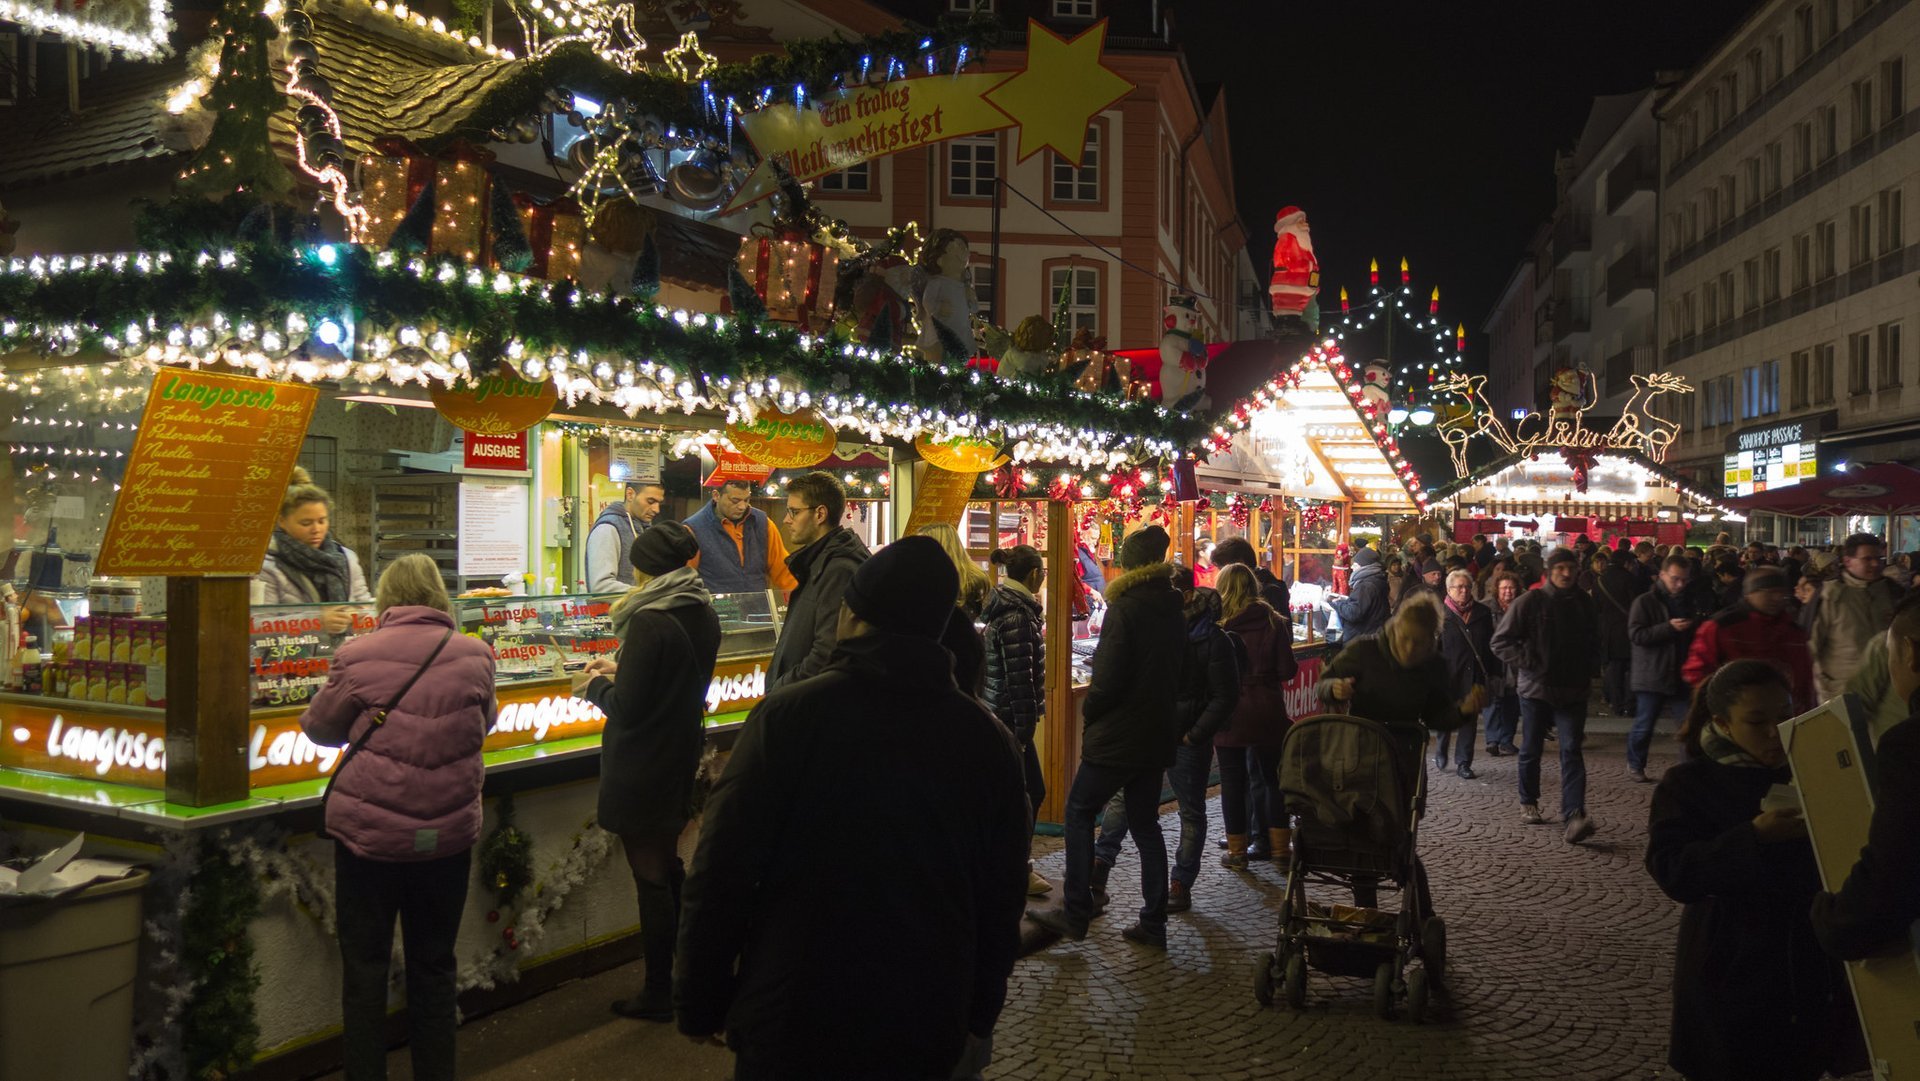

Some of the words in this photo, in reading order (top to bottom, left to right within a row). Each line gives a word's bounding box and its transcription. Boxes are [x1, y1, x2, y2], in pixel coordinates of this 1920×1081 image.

[819, 101, 851, 127] Ein
[856, 85, 910, 119] frohes
[162, 376, 276, 410] Langosch
[456, 416, 476, 428] mit
[481, 411, 512, 433] Käse
[1739, 430, 1770, 450] SANDHOF
[1772, 424, 1802, 444] PASSAGE
[142, 441, 193, 459] Nutella
[472, 443, 520, 458] AUSGABE
[482, 606, 537, 622] Langos
[249, 616, 322, 636] Langos
[256, 637, 276, 648] mit
[278, 635, 319, 645] Nutella
[570, 637, 620, 654] Langos
[491, 643, 547, 661] Langos
[254, 656, 330, 677] Langos
[258, 680, 278, 689] mit
[705, 664, 766, 713] gosch
[1283, 669, 1319, 718] üchte
[269, 687, 308, 704] 3,00
